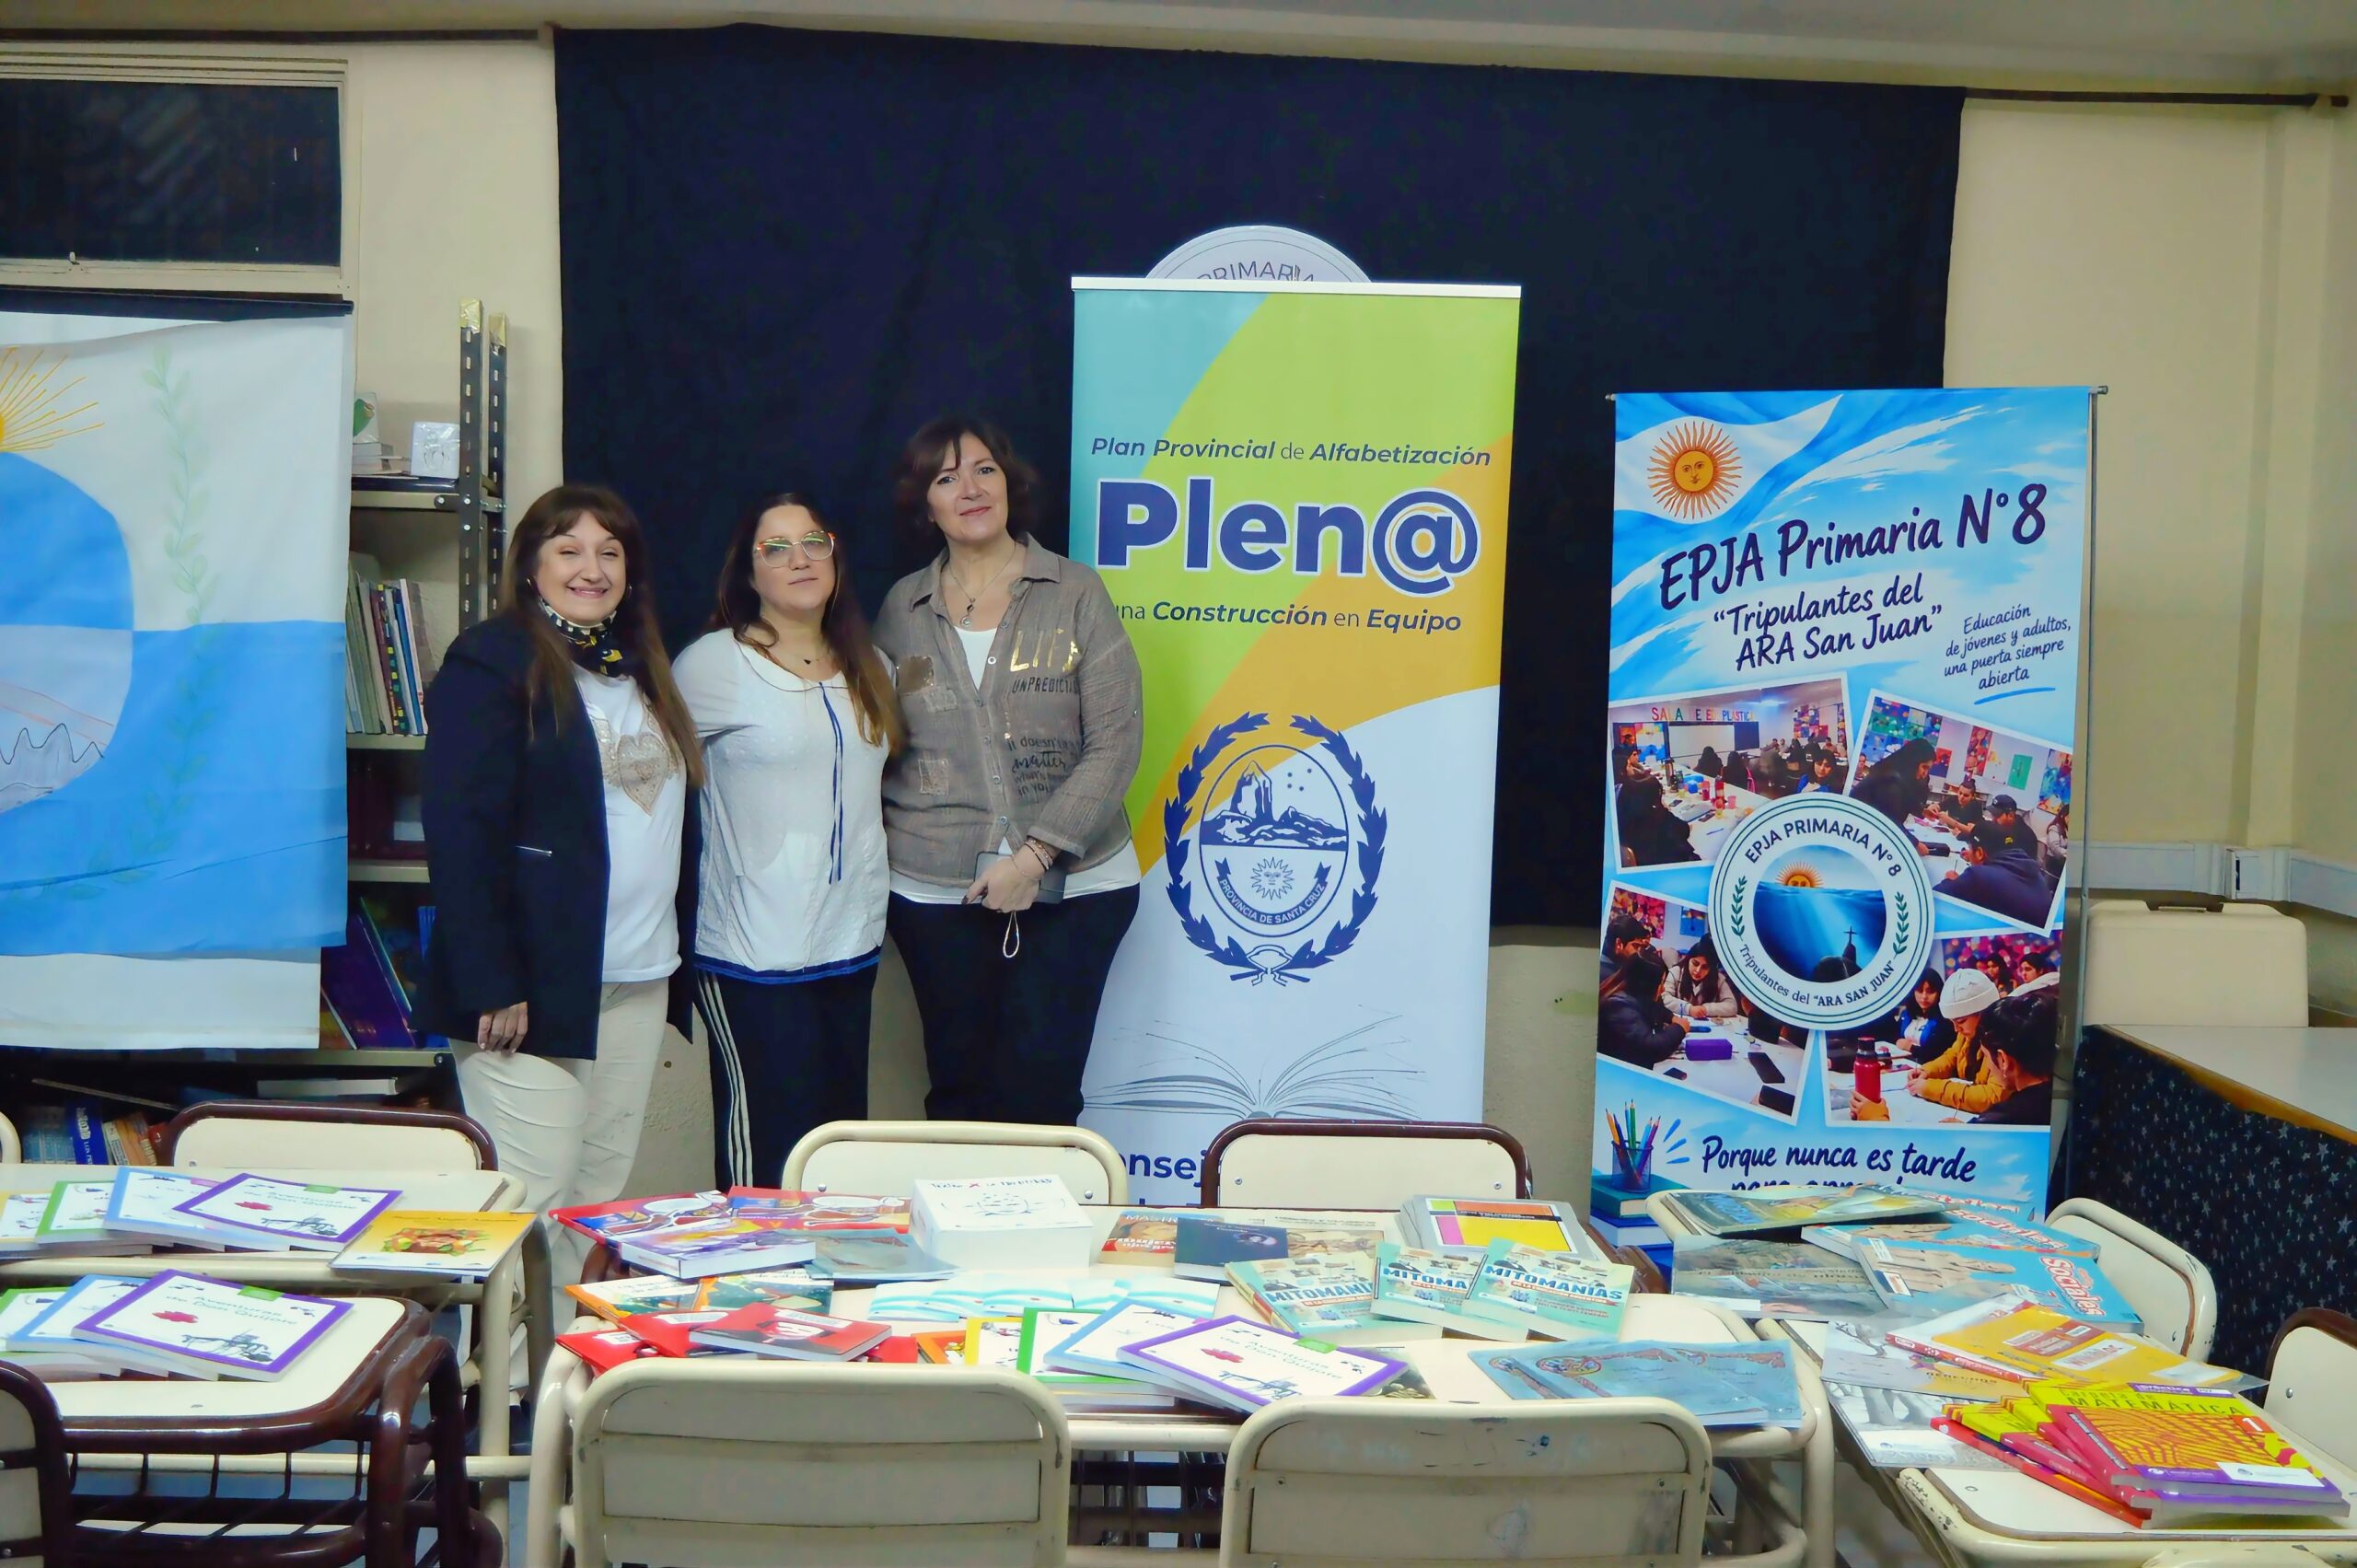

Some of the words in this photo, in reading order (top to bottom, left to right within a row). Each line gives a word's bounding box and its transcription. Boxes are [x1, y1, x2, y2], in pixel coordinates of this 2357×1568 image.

[1091, 437, 1145, 458] Plan
[1153, 438, 1275, 459] Provincial
[1281, 442, 1305, 460] de
[1309, 443, 1492, 466] Alfabetización
[1096, 476, 1480, 597] Plen@
[1660, 532, 1764, 610] EPJA
[1777, 507, 1943, 576] Primaria
[1153, 601, 1327, 626] Construcción
[1334, 612, 1360, 628] en
[1366, 609, 1462, 635] Equipo
[1713, 585, 1873, 636] “Tripulantes
[1883, 572, 1922, 612] del
[1963, 604, 2031, 634] Educación
[1736, 631, 1794, 671] ARA
[1804, 623, 1854, 659] San
[1862, 605, 1943, 650] Juan”
[1945, 638, 1960, 657] de
[1960, 630, 2006, 657] jóvenes
[2010, 630, 2018, 647] y
[2022, 615, 2072, 637] adultos,
[1945, 661, 1967, 678] una
[1970, 651, 2013, 677] puerta
[2015, 638, 2065, 666] siempre
[1978, 667, 2030, 691] abierta
[1745, 830, 1782, 864] EPJA
[1783, 818, 1869, 849] PRIMARIA
[1888, 864, 1902, 877] 8
[1219, 878, 1257, 922] PROVINCIA
[1260, 913, 1272, 924] DE
[1274, 904, 1306, 924] SANTA
[1304, 883, 1326, 910] CRUZ
[1739, 945, 1790, 997] Tripulantes
[1792, 989, 1809, 1005] del
[1845, 988, 1869, 1004] SAN
[1701, 1135, 1776, 1178] Porque
[1785, 1146, 1856, 1169] nunca
[1866, 1153, 1892, 1173] es
[1900, 1143, 1977, 1183] tarde
[2242, 1417, 2264, 1433] 1
